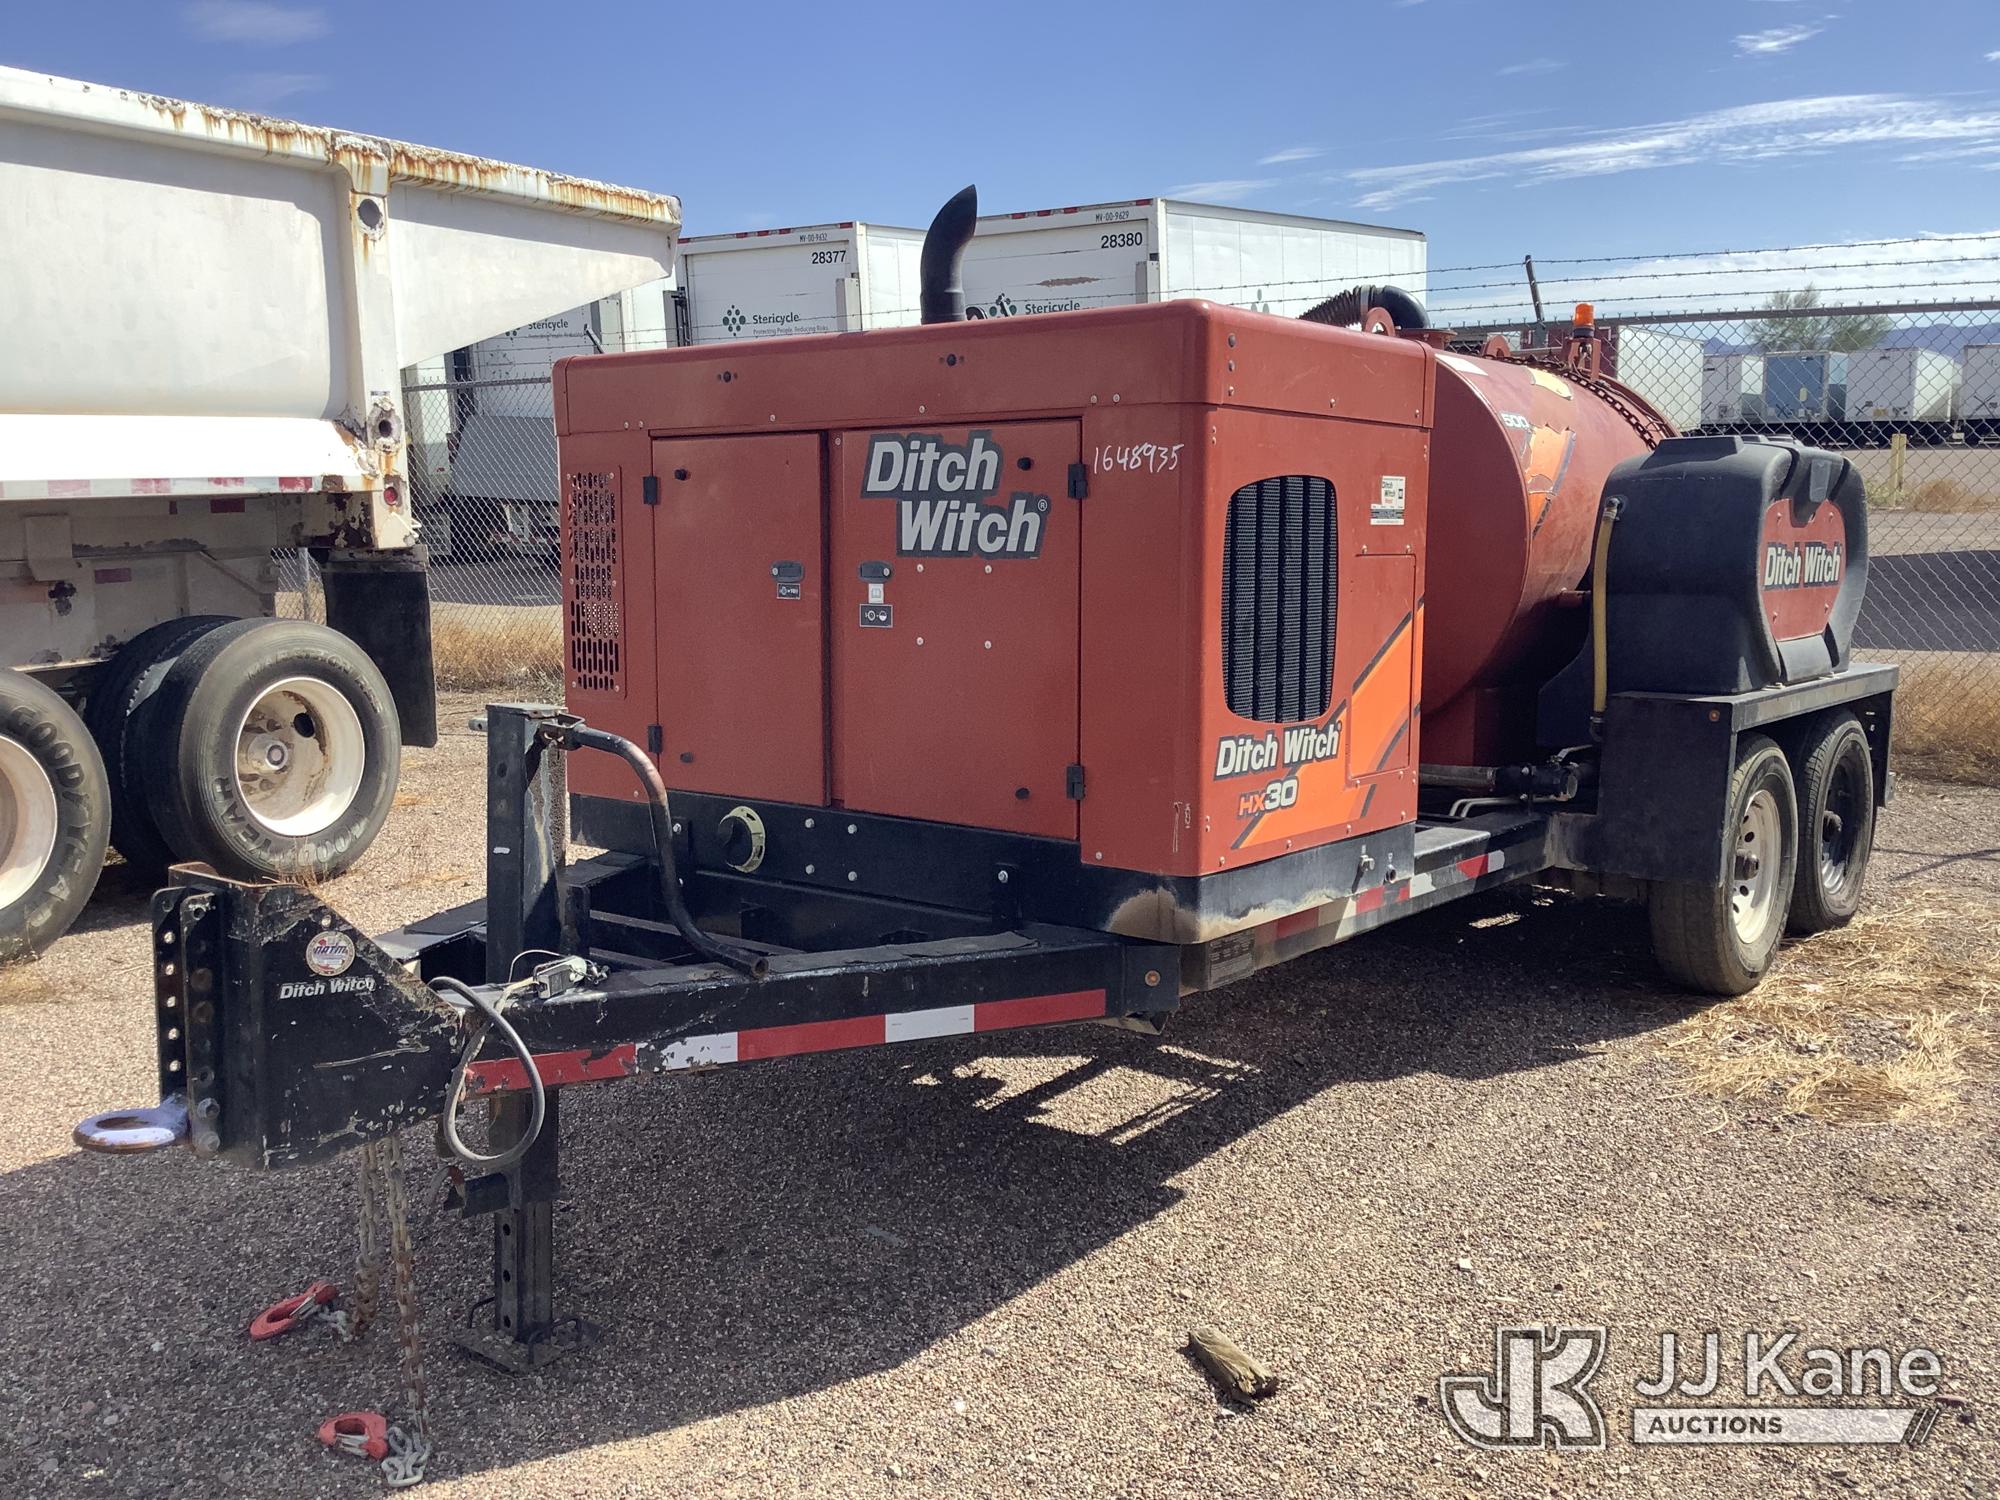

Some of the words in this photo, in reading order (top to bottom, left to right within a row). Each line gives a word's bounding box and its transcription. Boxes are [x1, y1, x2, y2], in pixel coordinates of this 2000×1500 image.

[1101, 232, 1143, 249] 28380
[812, 250, 846, 265] 28377
[752, 312, 800, 326] Stericycle
[1024, 300, 1081, 315] Stericycle
[867, 438, 999, 492] Ditch
[1094, 442, 1185, 475] 1648935
[1763, 546, 1802, 586] Ditch
[1804, 546, 1841, 583] Witch
[1216, 733, 1278, 777] Ditch
[1239, 779, 1298, 816] HX30
[280, 981, 325, 999] Ditch
[330, 976, 376, 994] Witch
